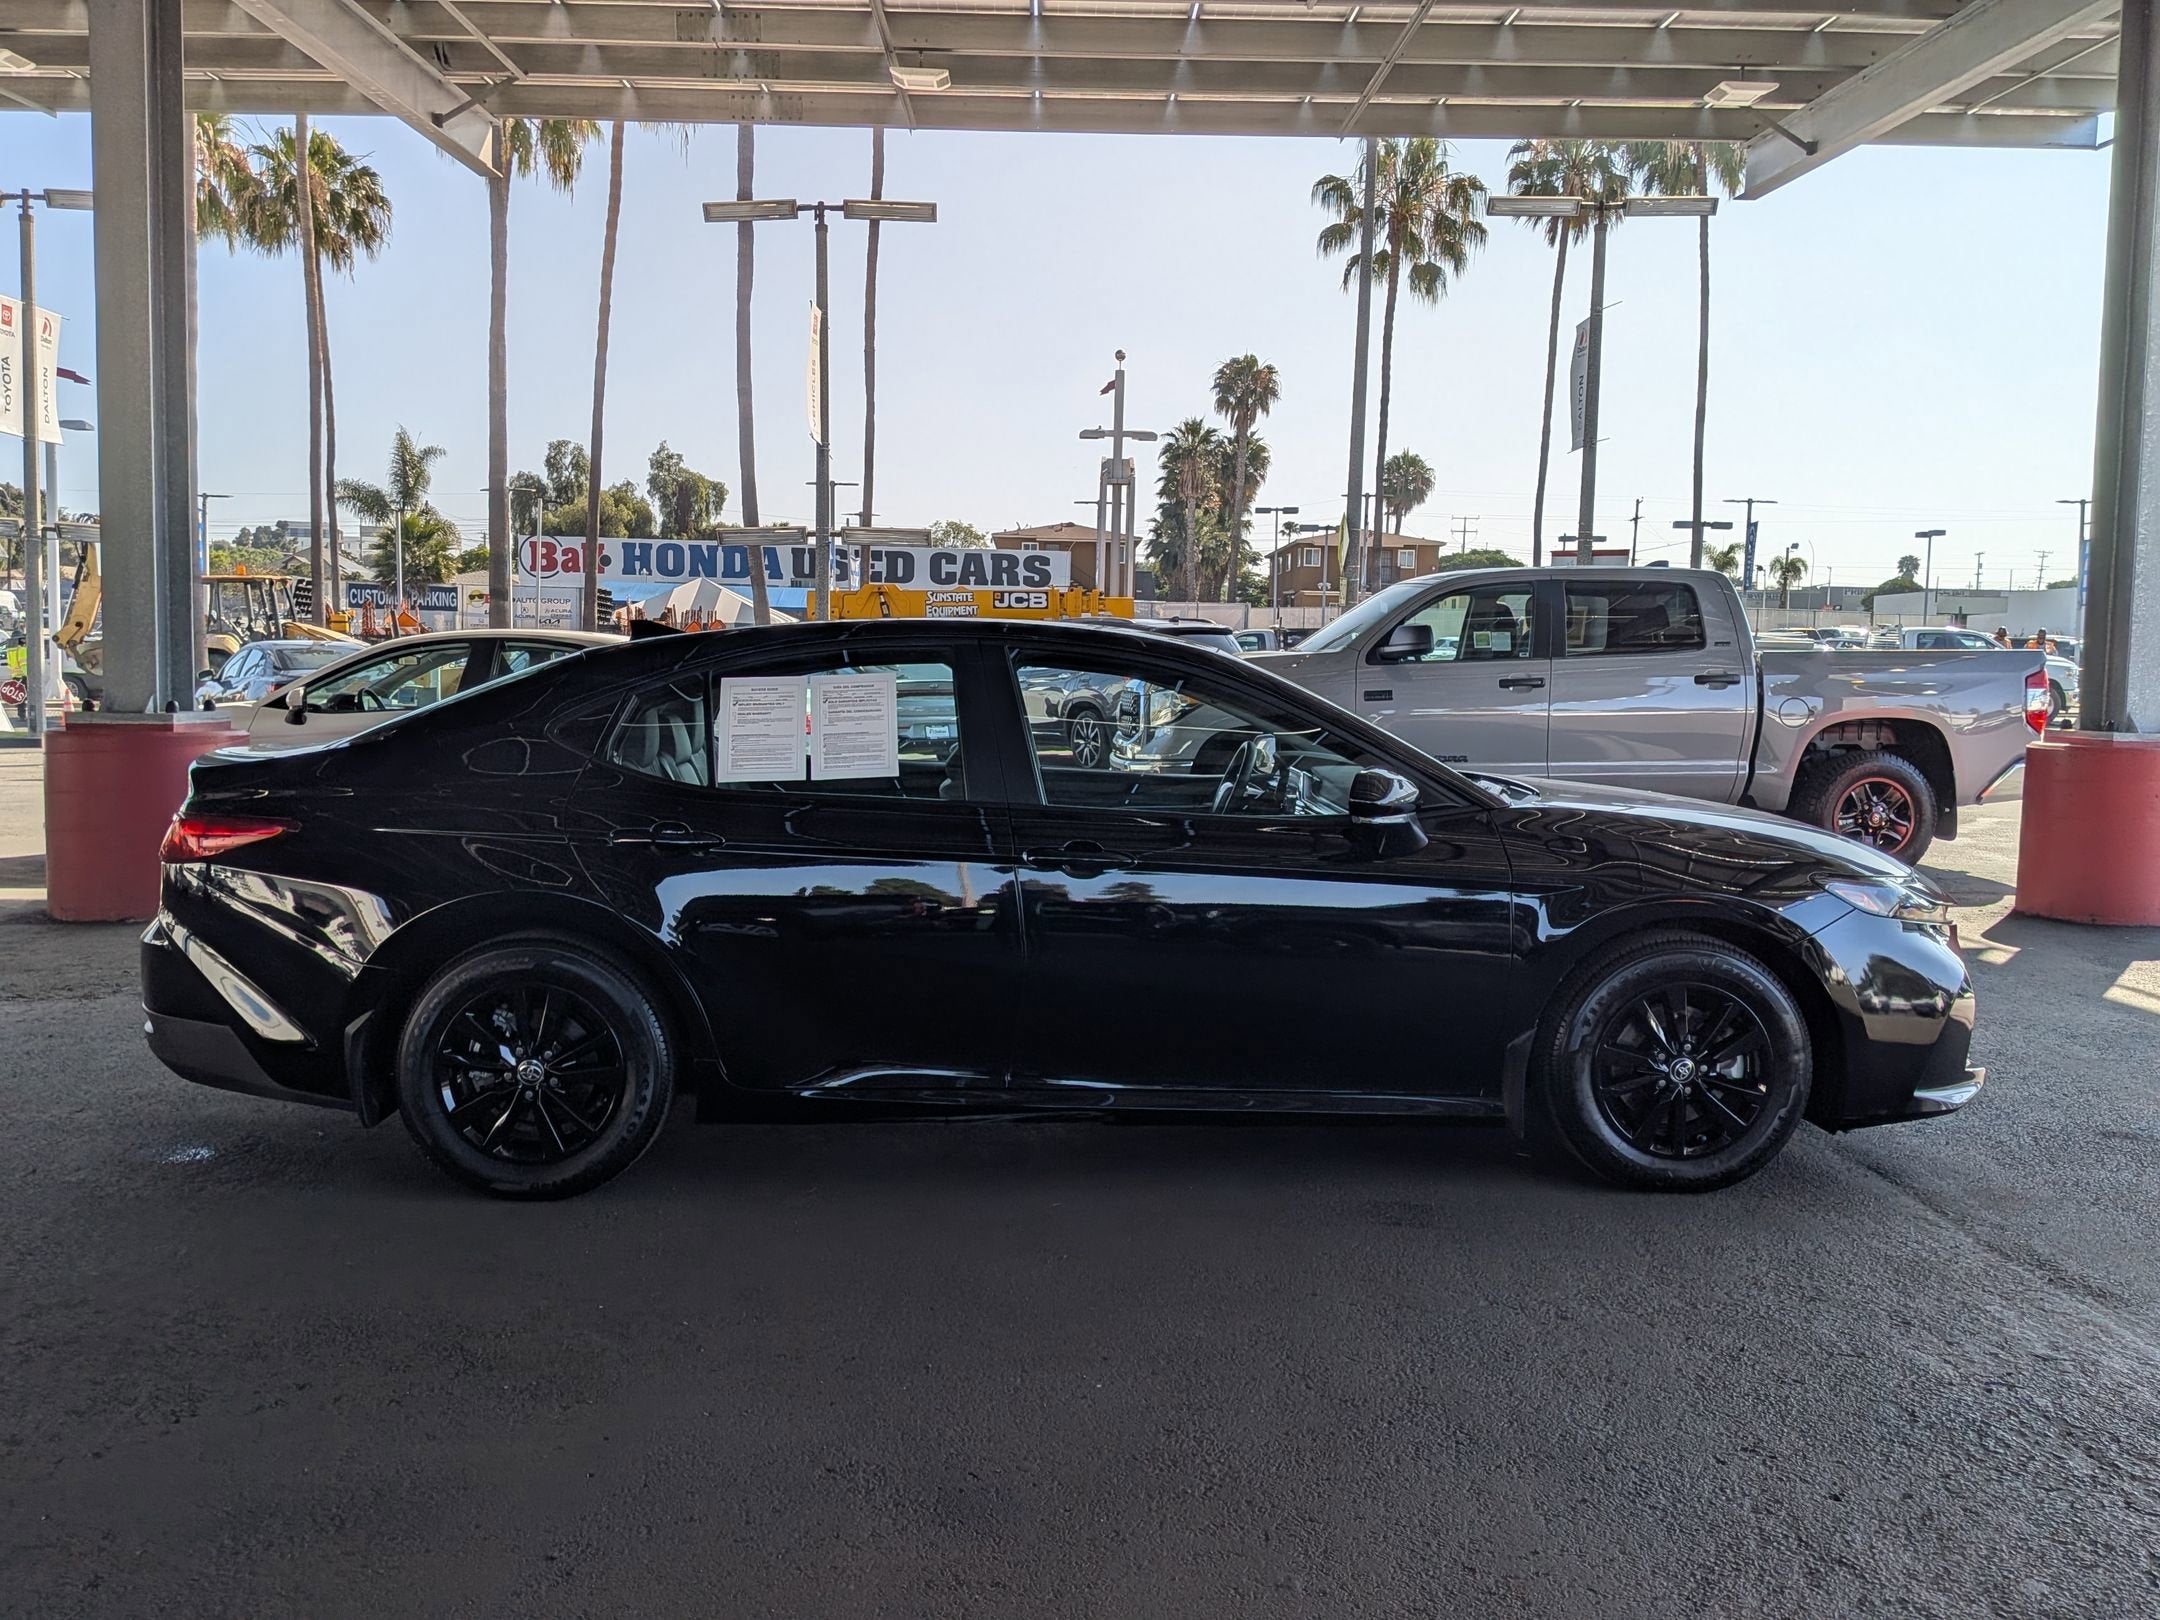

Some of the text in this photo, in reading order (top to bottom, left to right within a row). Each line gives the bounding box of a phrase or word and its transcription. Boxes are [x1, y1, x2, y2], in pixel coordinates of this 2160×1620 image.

[1, 356, 12, 414] TOYOTA
[621, 542, 784, 580] HONDA
[790, 547, 915, 584] USED
[929, 551, 1052, 589] CARS
[350, 588, 457, 608] CUSTOM PARKING
[540, 597, 571, 605] GROUP
[926, 591, 973, 604] SUNSTATE
[994, 592, 1048, 608] JCB
[926, 605, 979, 618] EQUIPMENT
[1, 685, 24, 701] STOP
